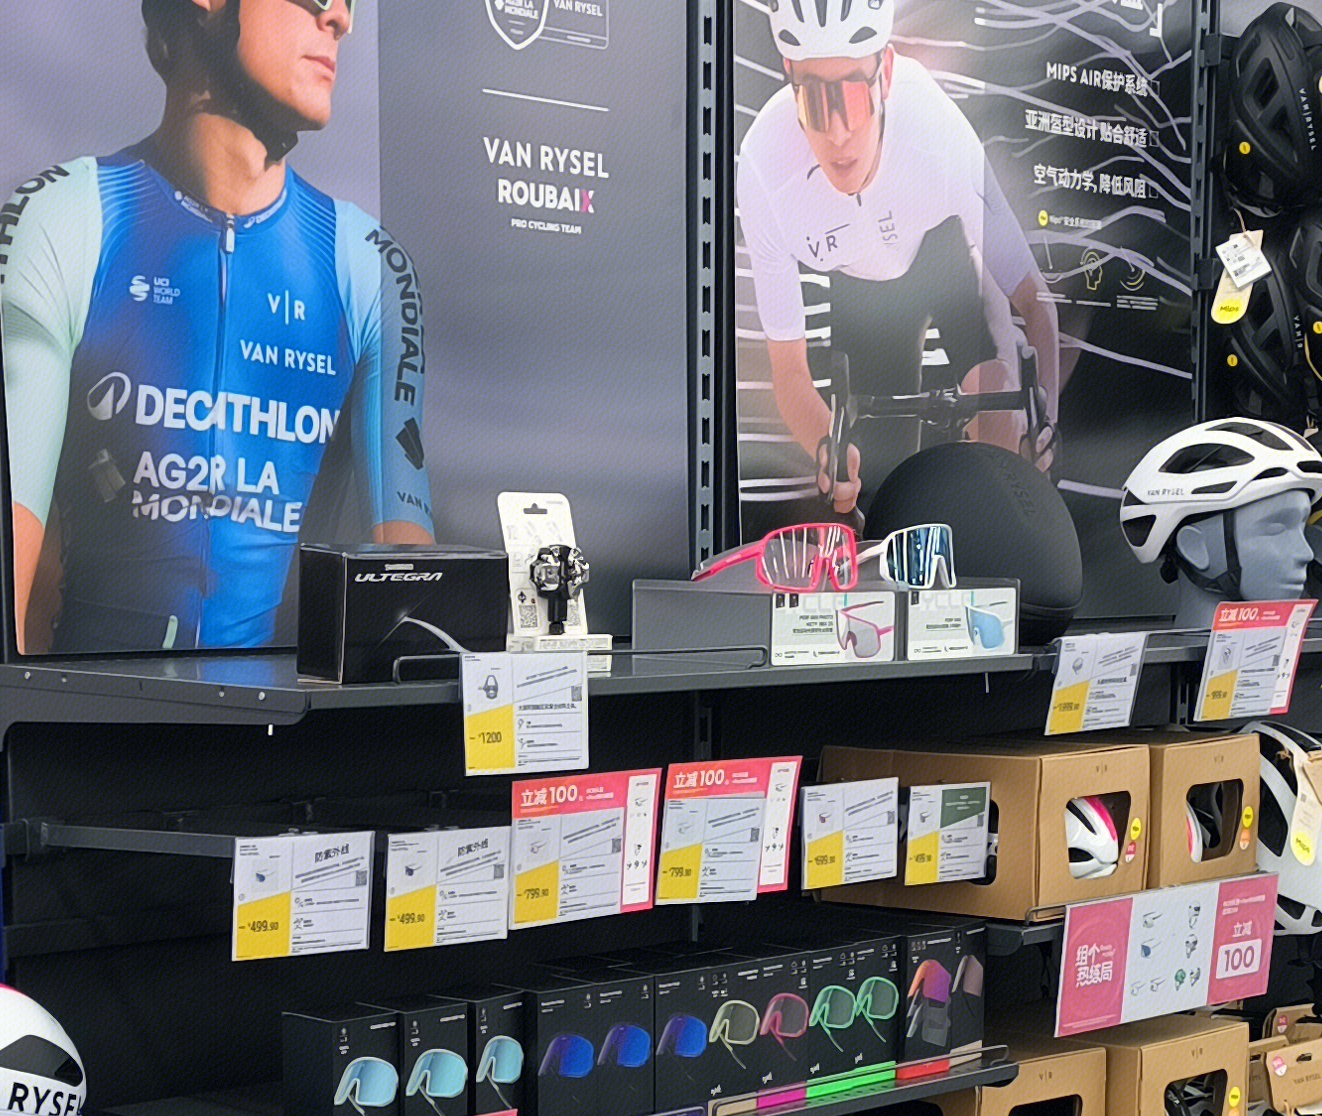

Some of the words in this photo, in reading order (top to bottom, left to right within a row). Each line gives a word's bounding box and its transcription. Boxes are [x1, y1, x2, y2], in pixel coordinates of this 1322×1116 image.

[575, 1, 603, 16] RYSEL
[1046, 62, 1077, 83] MIPS
[483, 137, 532, 169] VAN
[540, 145, 609, 179] RYSEL
[498, 178, 595, 214] ROUBAIX
[511, 218, 527, 229] PRO
[528, 220, 560, 233] CYCLING
[561, 223, 582, 235] TEAM
[153, 286, 180, 298] WORLD
[153, 295, 173, 305] TEAM
[364, 227, 427, 405] MONDIALE
[239, 339, 278, 365] VAN
[285, 347, 336, 376] RYSEL
[135, 384, 340, 445] DECATHLON
[133, 451, 226, 495] AG2R
[237, 455, 280, 495] LA
[131, 489, 304, 534] MONDIALE
[355, 571, 444, 583] ULTEGRA
[1232, 918, 1254, 938] 立减
[1223, 945, 1255, 973] 100
